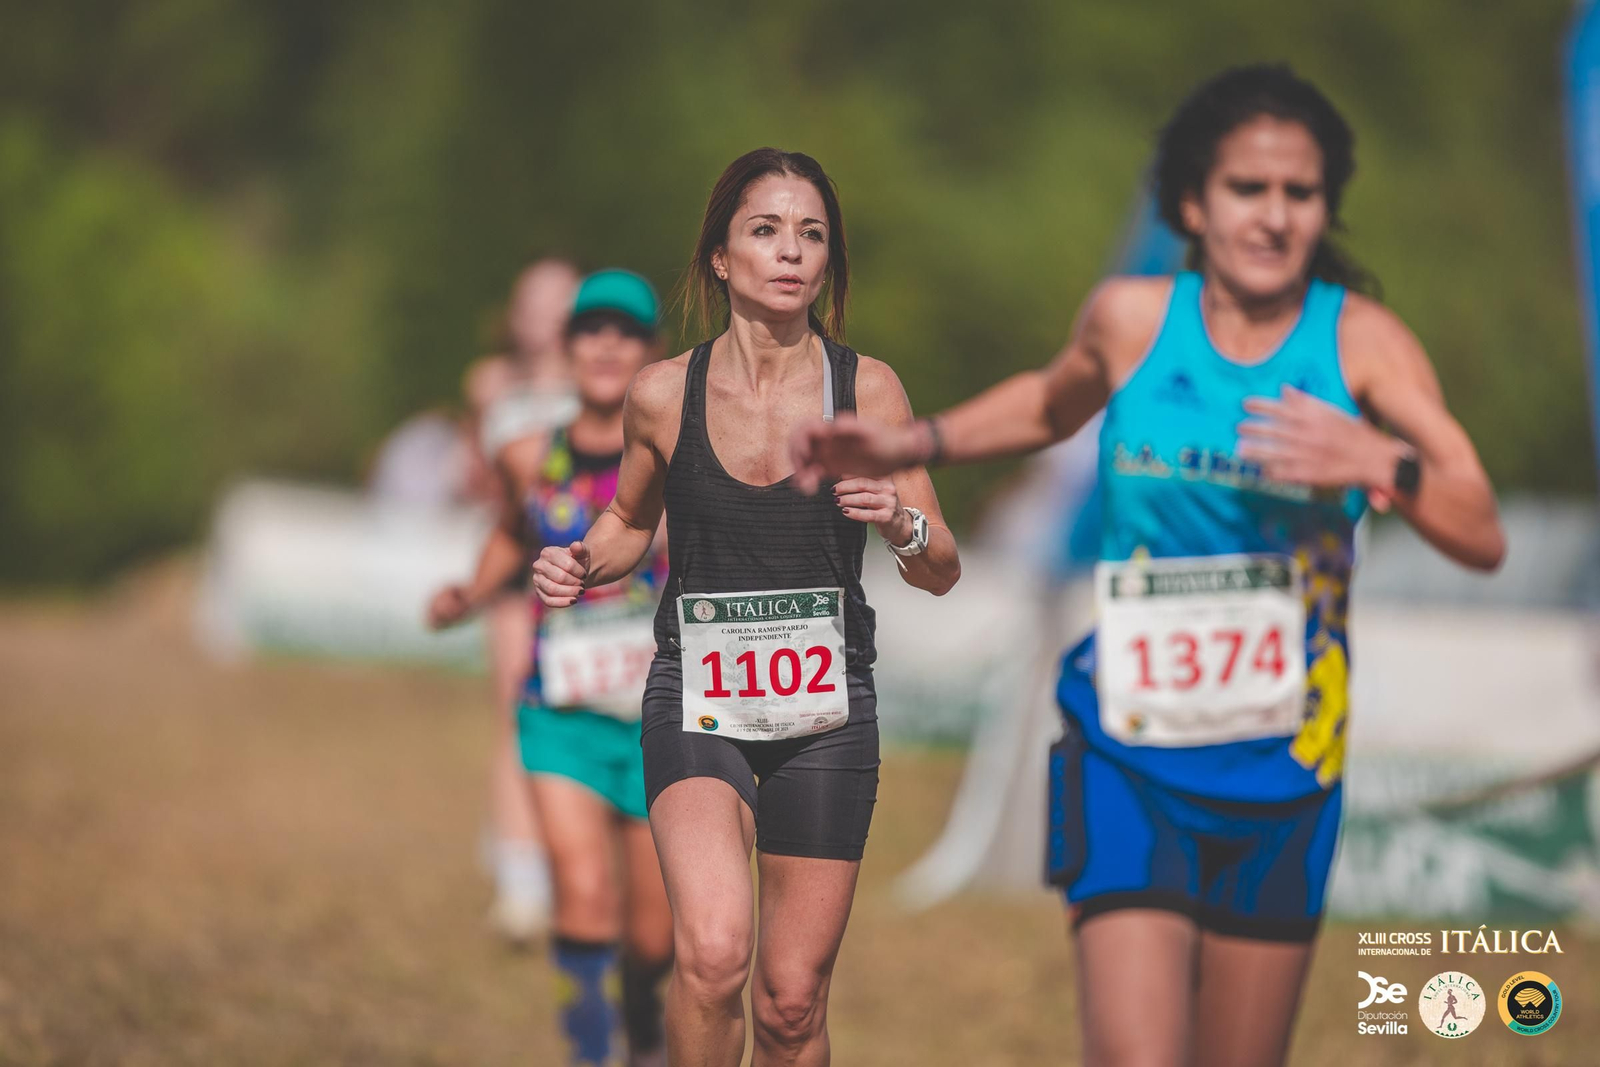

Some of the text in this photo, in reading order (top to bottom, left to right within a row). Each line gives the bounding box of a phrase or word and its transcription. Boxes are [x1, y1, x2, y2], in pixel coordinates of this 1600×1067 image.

[726, 598, 801, 618] ITÁLICA
[738, 634, 792, 642] INDEPENDIENTE
[757, 626, 781, 634] RAMOS
[782, 624, 808, 632] PAREJO
[1127, 623, 1286, 692] 1374
[702, 645, 836, 698] 1102
